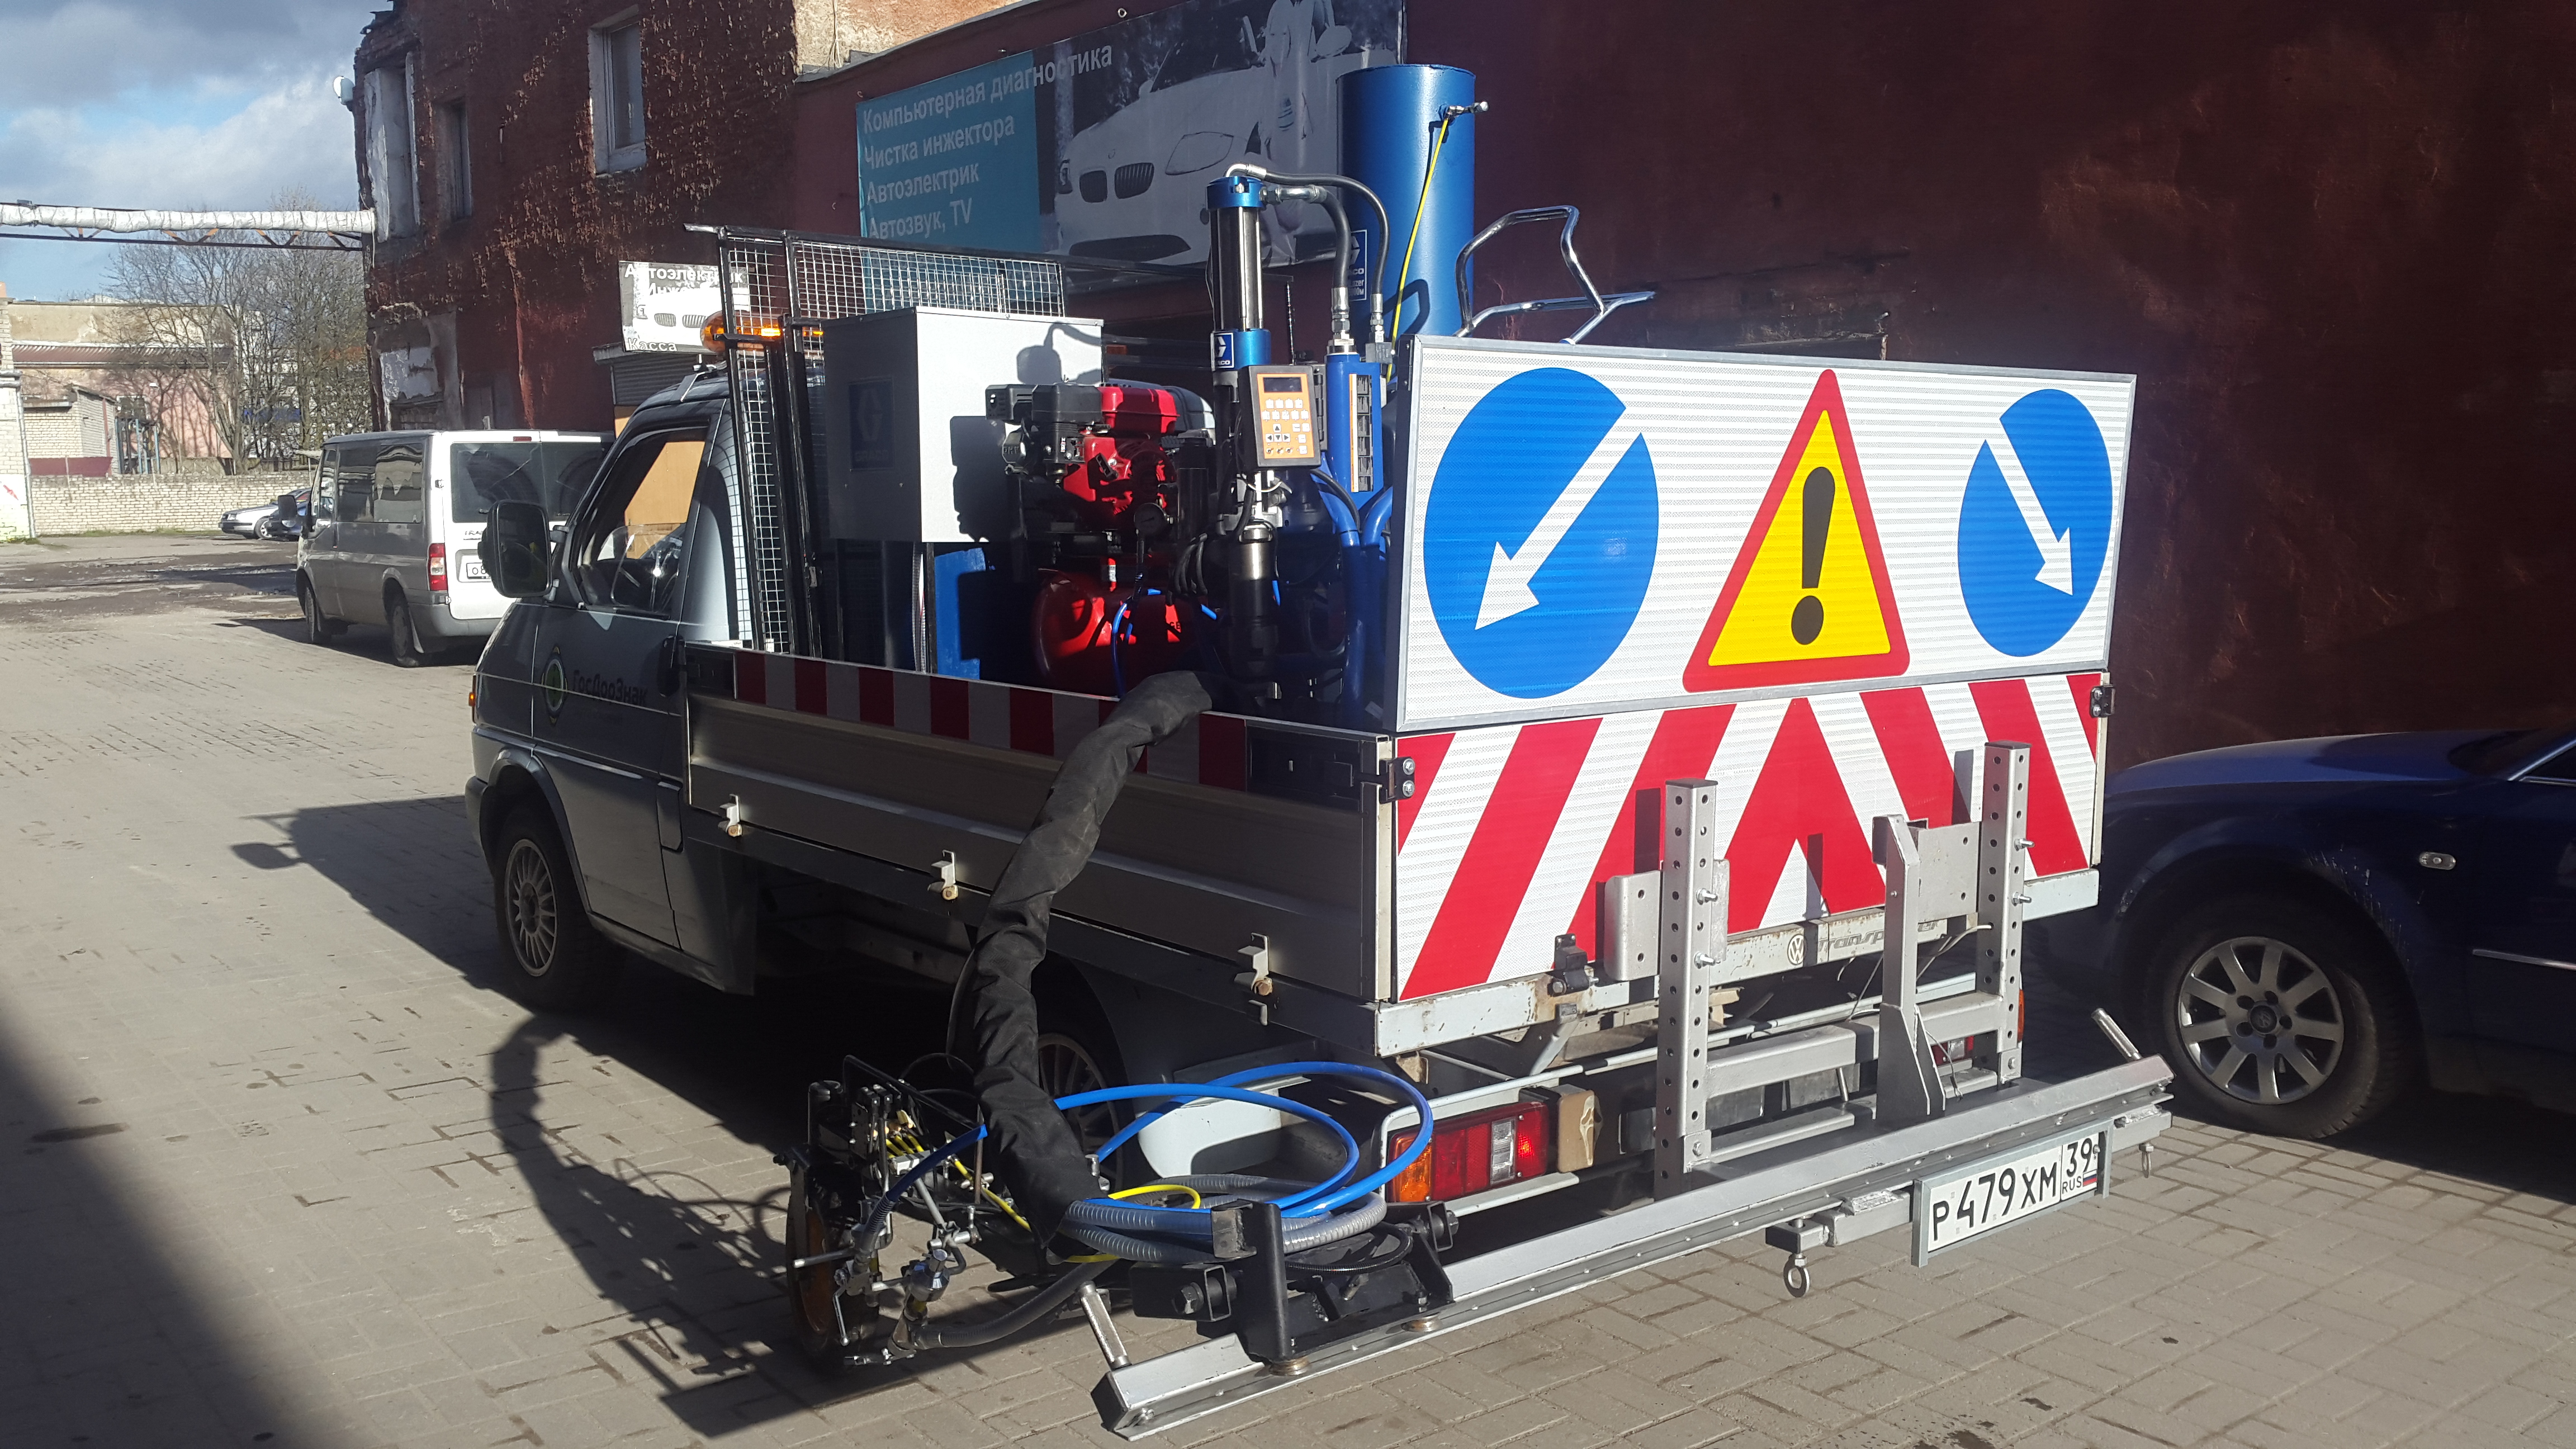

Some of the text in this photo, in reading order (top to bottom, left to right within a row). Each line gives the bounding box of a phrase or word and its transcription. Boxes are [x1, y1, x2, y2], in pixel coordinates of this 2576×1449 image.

[863, 44, 1112, 134] Компьютерная диагностика
[864, 115, 1015, 169] Чистка инжектора
[866, 163, 979, 205] Автоэлектрик
[869, 198, 973, 240] Автозвук, TV
[624, 263, 744, 285] Атоэлектрк
[627, 338, 678, 352] Касса
[2067, 1138, 2093, 1177] 39
[2062, 1176, 2082, 1194] RUS
